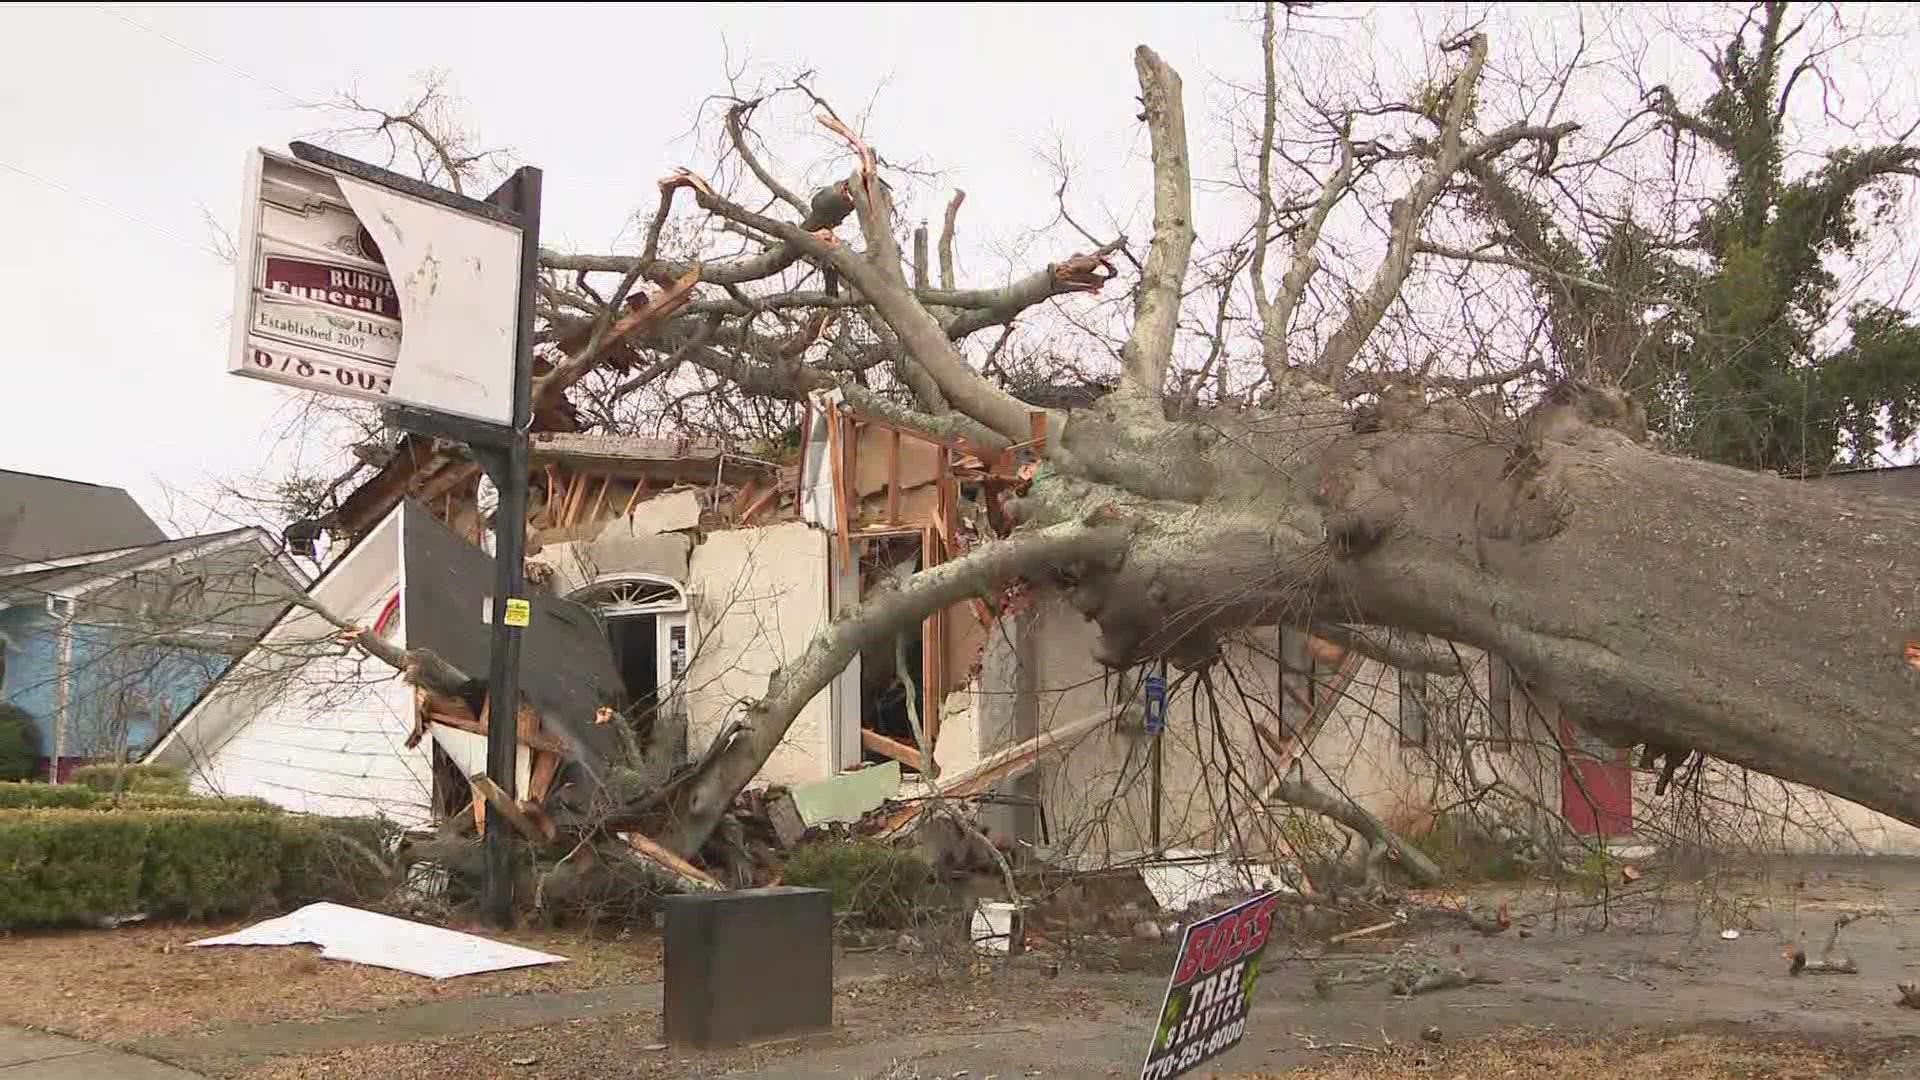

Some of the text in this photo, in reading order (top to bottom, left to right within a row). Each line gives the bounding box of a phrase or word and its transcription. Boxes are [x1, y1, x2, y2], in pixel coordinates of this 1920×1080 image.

[271, 280, 384, 312] Funeral
[260, 312, 332, 341] Established
[1172, 896, 1278, 988] BOSS
[1186, 961, 1246, 1016] TREE
[1144, 1017, 1246, 1080] 770-251-8000
[1164, 992, 1246, 1050] SERVICE
